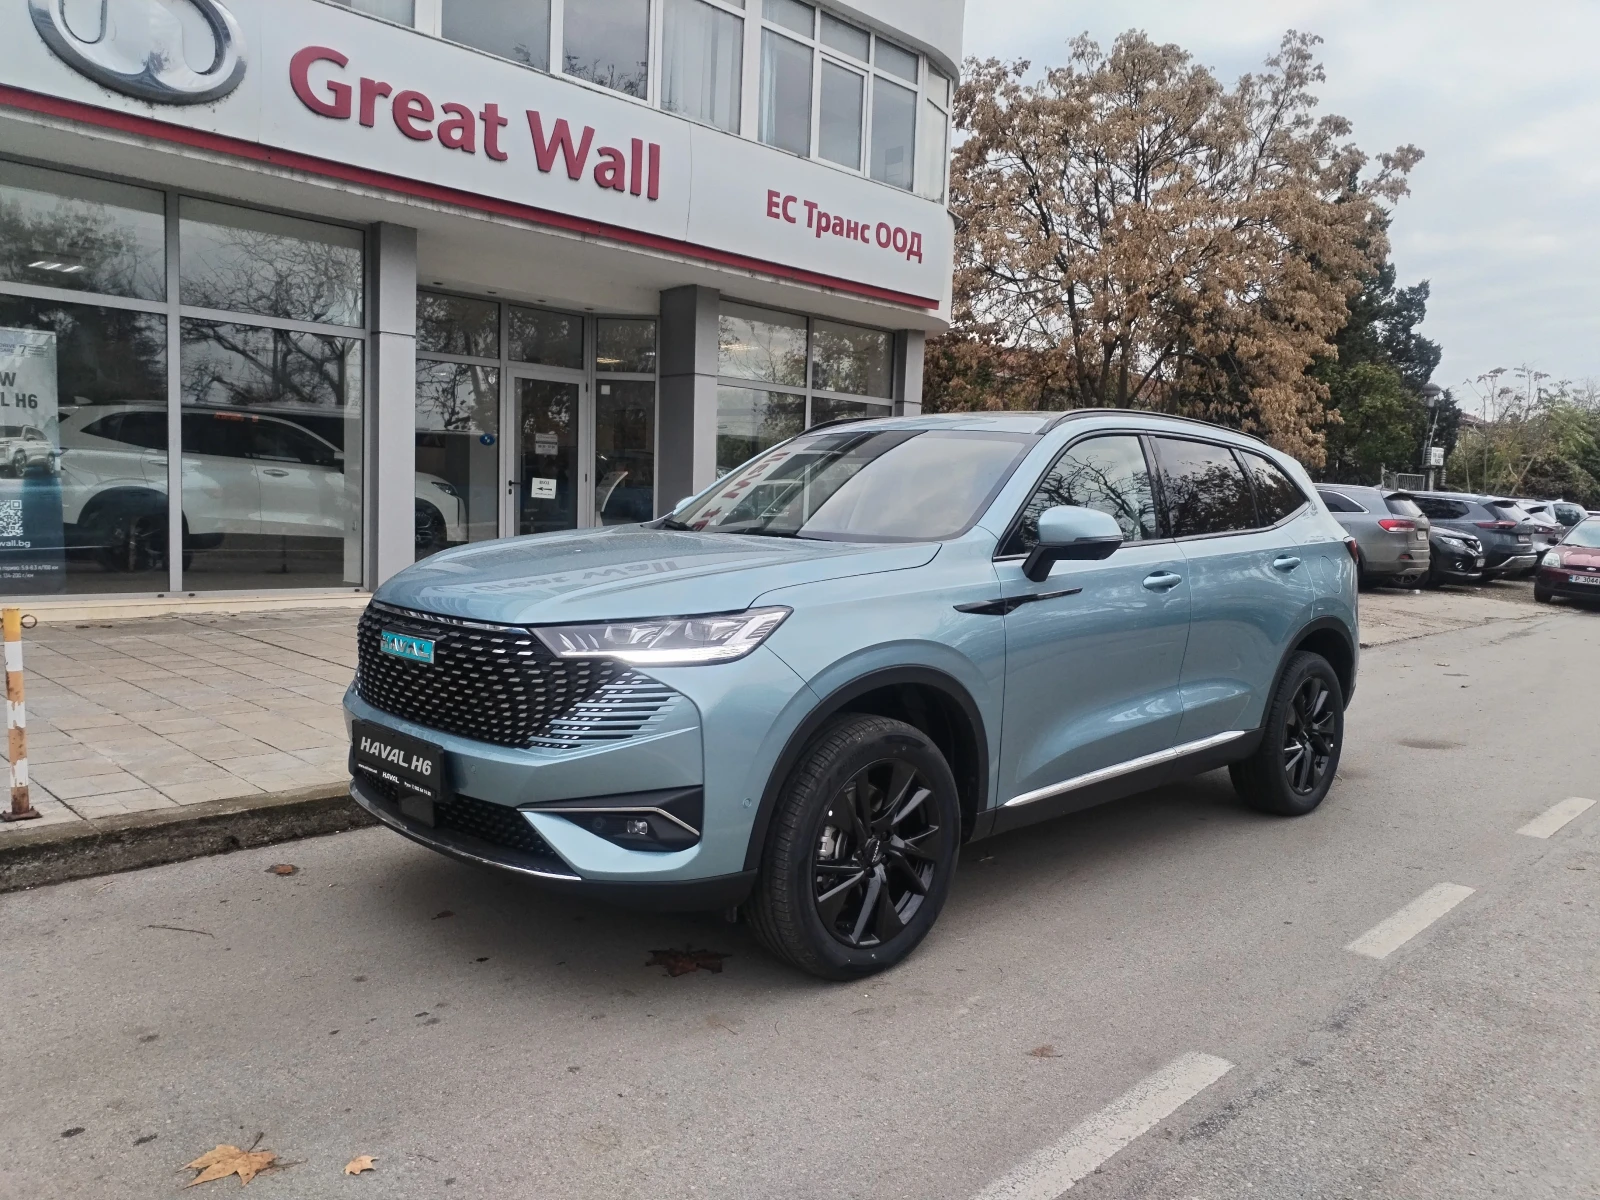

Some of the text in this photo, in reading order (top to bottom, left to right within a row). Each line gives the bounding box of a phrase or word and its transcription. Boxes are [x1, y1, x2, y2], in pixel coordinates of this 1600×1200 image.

[289, 44, 661, 201] Great Wall
[766, 188, 923, 264] ЕС Транс ООД
[15, 393, 38, 409] H6
[380, 634, 430, 658] HAVAL
[360, 736, 432, 776] HAVAL H6
[382, 771, 400, 784] HAVAL
